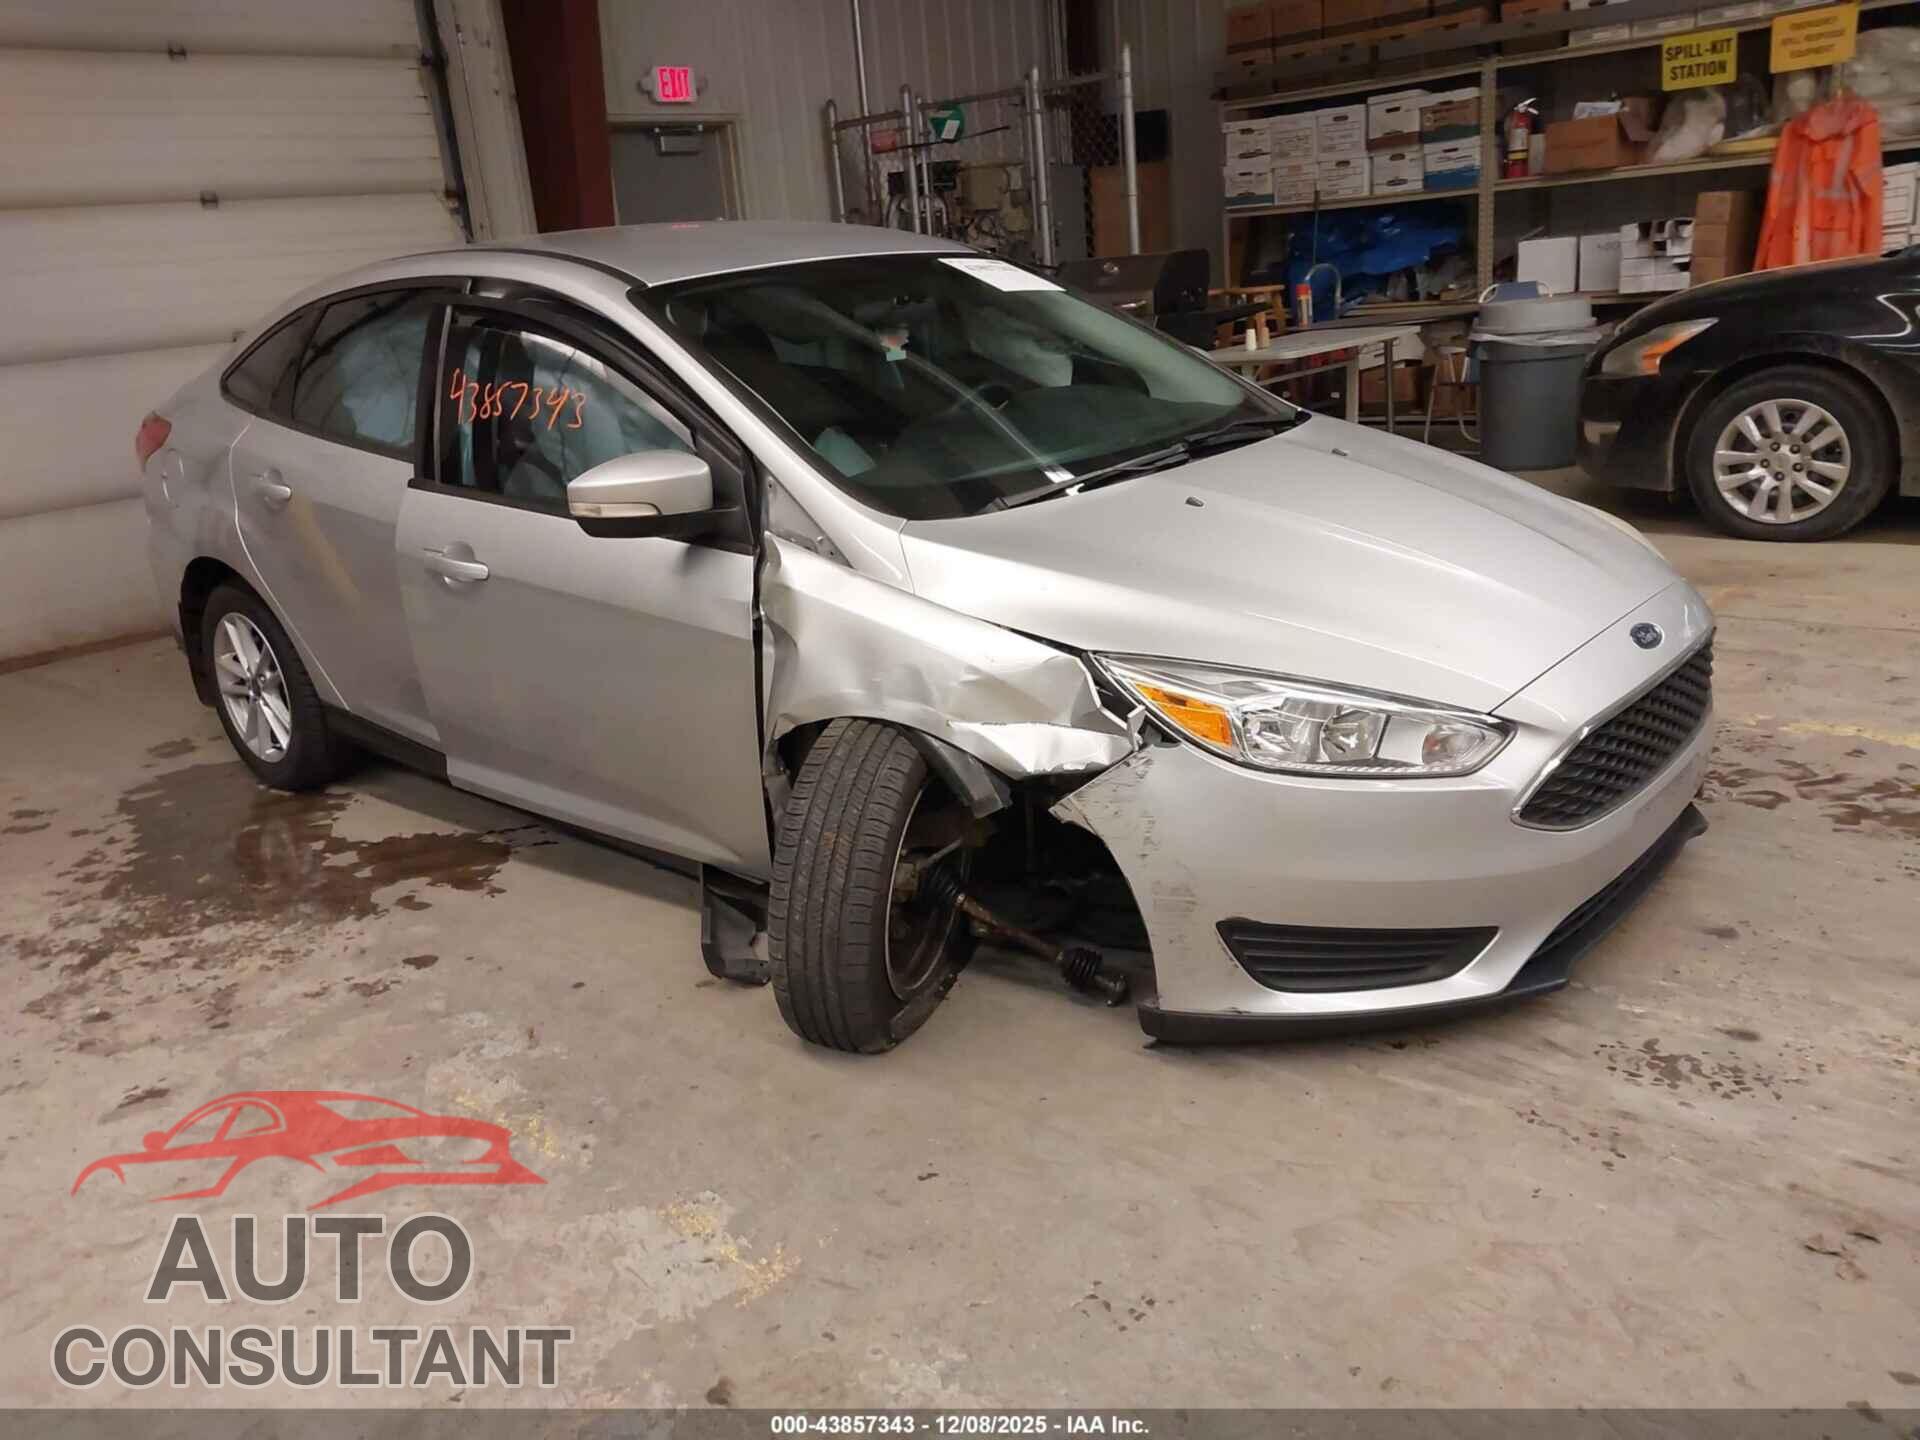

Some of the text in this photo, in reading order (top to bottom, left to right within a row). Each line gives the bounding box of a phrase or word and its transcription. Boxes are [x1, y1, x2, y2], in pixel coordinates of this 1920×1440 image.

[1665, 38, 1733, 62] SPILL-KIT
[659, 68, 689, 98] EXIT
[1670, 60, 1727, 81] STATION
[450, 368, 586, 430] 43857343
